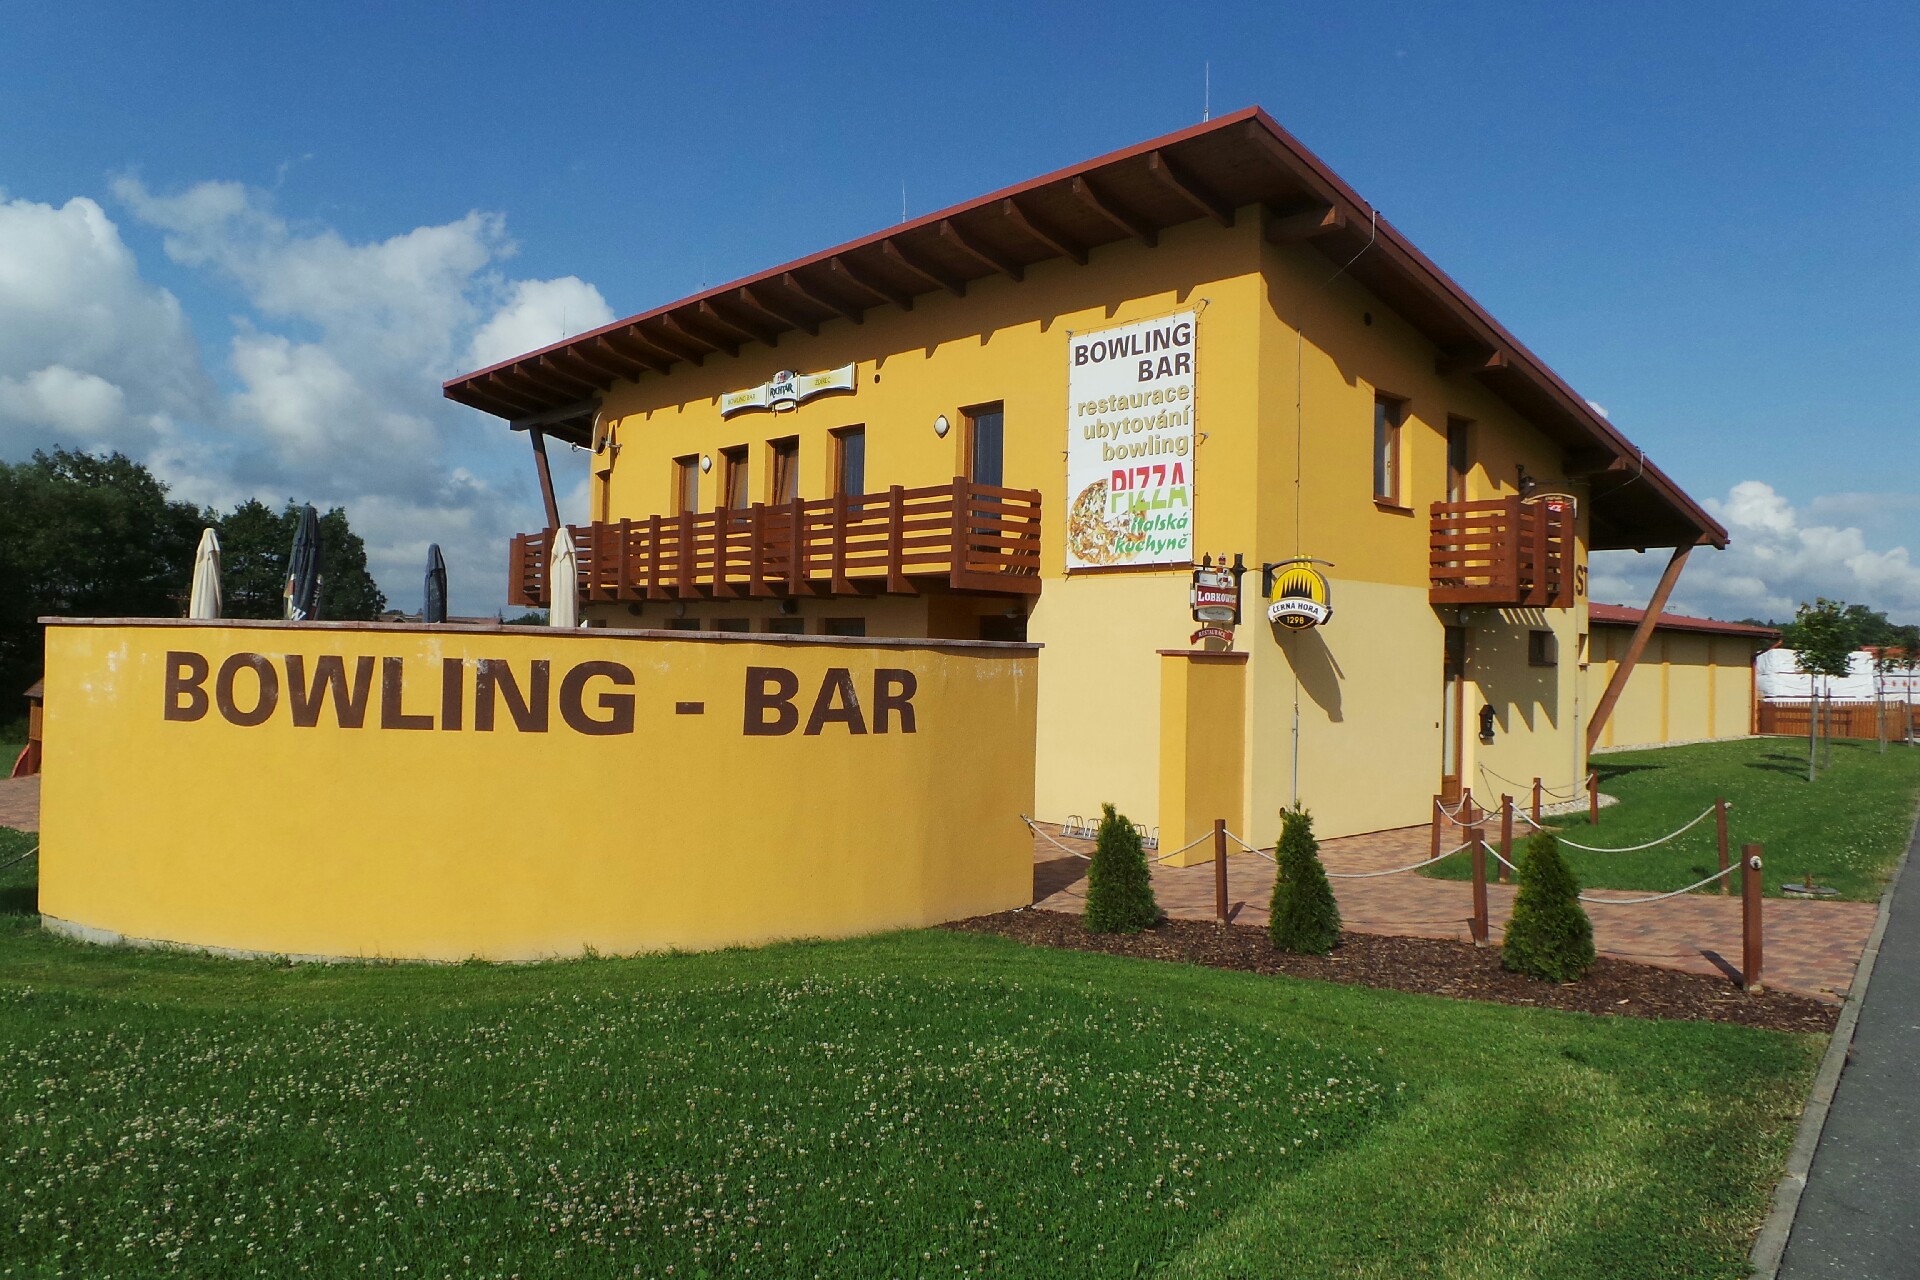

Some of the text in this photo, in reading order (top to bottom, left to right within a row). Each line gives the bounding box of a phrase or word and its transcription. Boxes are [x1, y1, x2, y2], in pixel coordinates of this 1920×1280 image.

[1075, 322, 1191, 367] BOWLING
[1138, 352, 1191, 382] BAR
[727, 395, 746, 405] BOWLING
[1077, 384, 1190, 417] restaurace
[1083, 405, 1191, 440] ubytování
[1102, 434, 1189, 462] bowling
[1131, 512, 1188, 533] italská
[1114, 533, 1188, 555] kuchyně
[1272, 601, 1319, 615] ČERNÁ HORA
[1286, 616, 1305, 625] 1298
[164, 650, 636, 736] BOWLING
[743, 666, 918, 737] BAR
